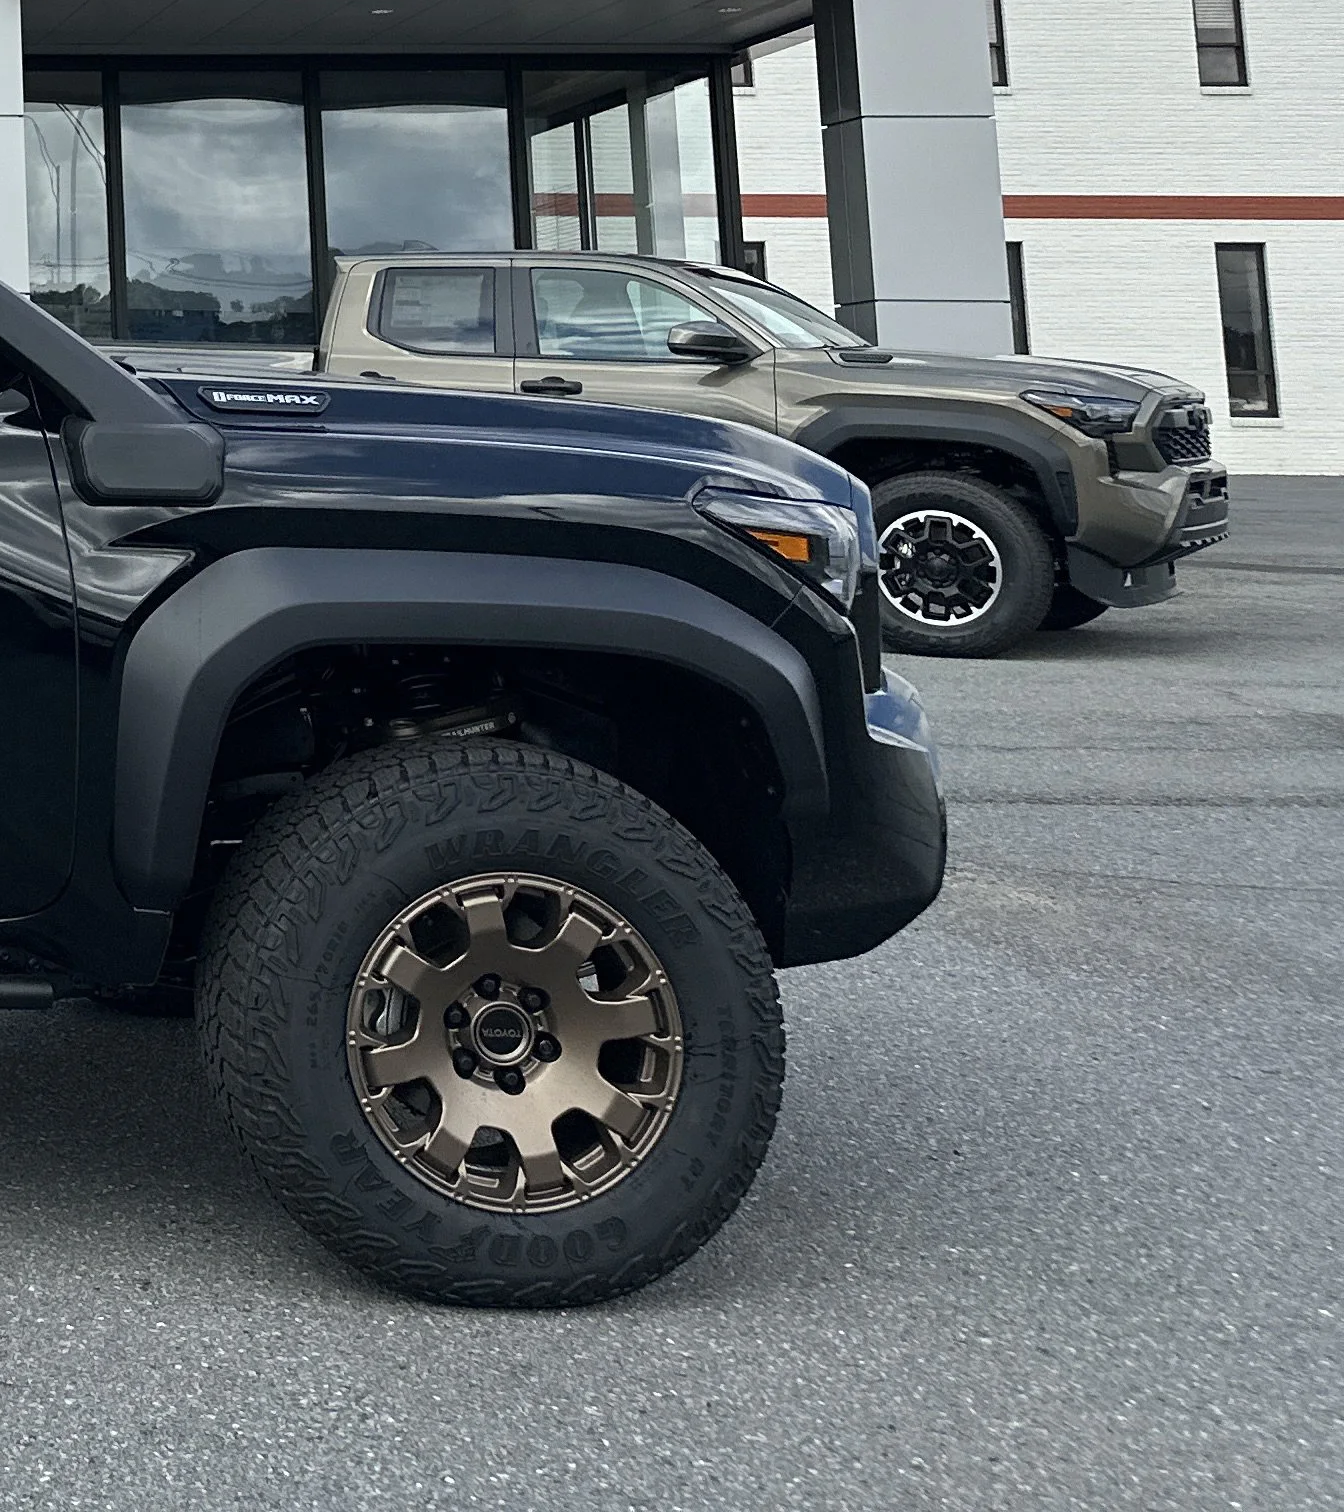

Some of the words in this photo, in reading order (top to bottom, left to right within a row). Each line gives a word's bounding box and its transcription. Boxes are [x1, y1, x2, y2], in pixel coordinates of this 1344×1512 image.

[266, 393, 320, 405] MAX
[425, 828, 702, 947] WRANGLER
[481, 1028, 522, 1039] TOYOTA
[330, 1129, 627, 1267] GOODYEAR
